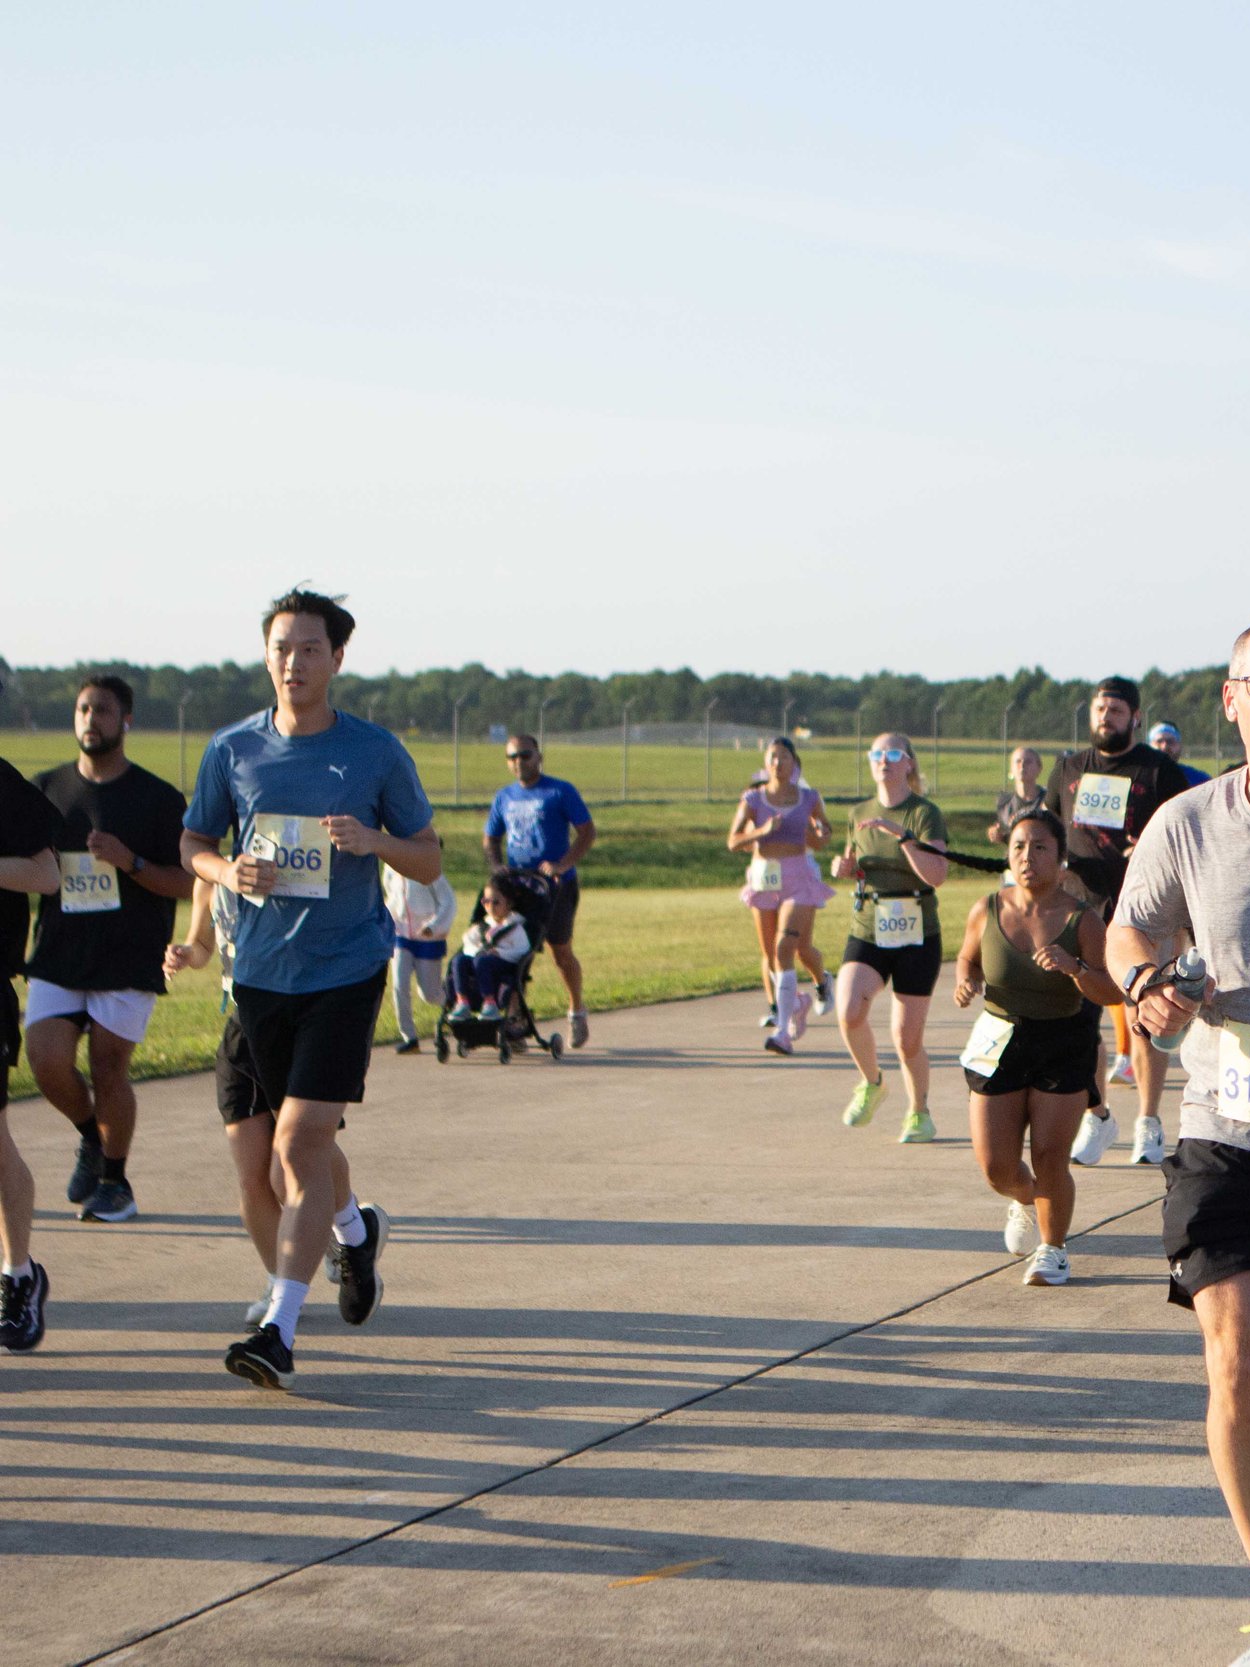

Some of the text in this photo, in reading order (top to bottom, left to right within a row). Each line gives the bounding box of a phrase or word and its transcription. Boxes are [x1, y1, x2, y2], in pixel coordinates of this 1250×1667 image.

[1080, 792, 1121, 810] 3978
[65, 874, 112, 893] 3570
[878, 917, 918, 932] 3097
